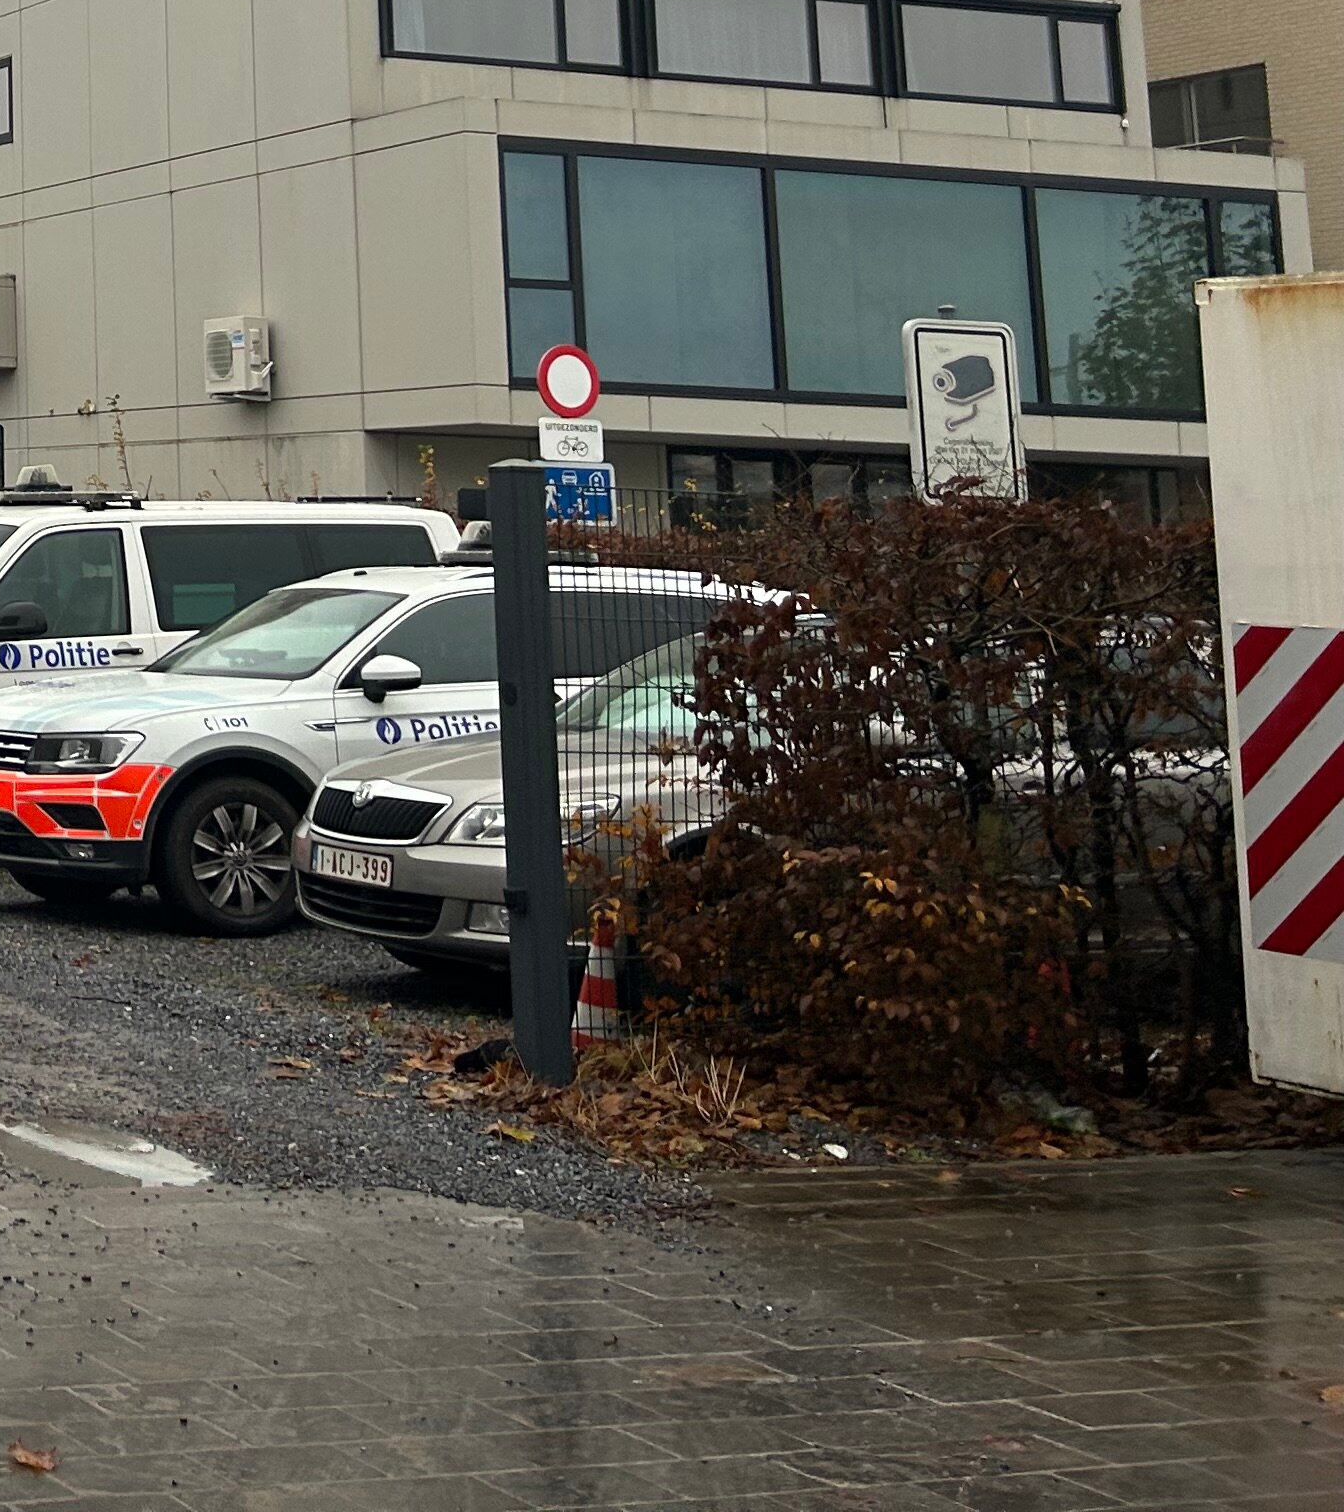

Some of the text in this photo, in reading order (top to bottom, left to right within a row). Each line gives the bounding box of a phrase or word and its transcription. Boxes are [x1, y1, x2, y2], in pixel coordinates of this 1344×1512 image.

[545, 422, 598, 433] UITGEZONDERD
[29, 641, 111, 669] Politie
[222, 717, 249, 728] 101
[320, 848, 389, 883] 1-ACJ-399
